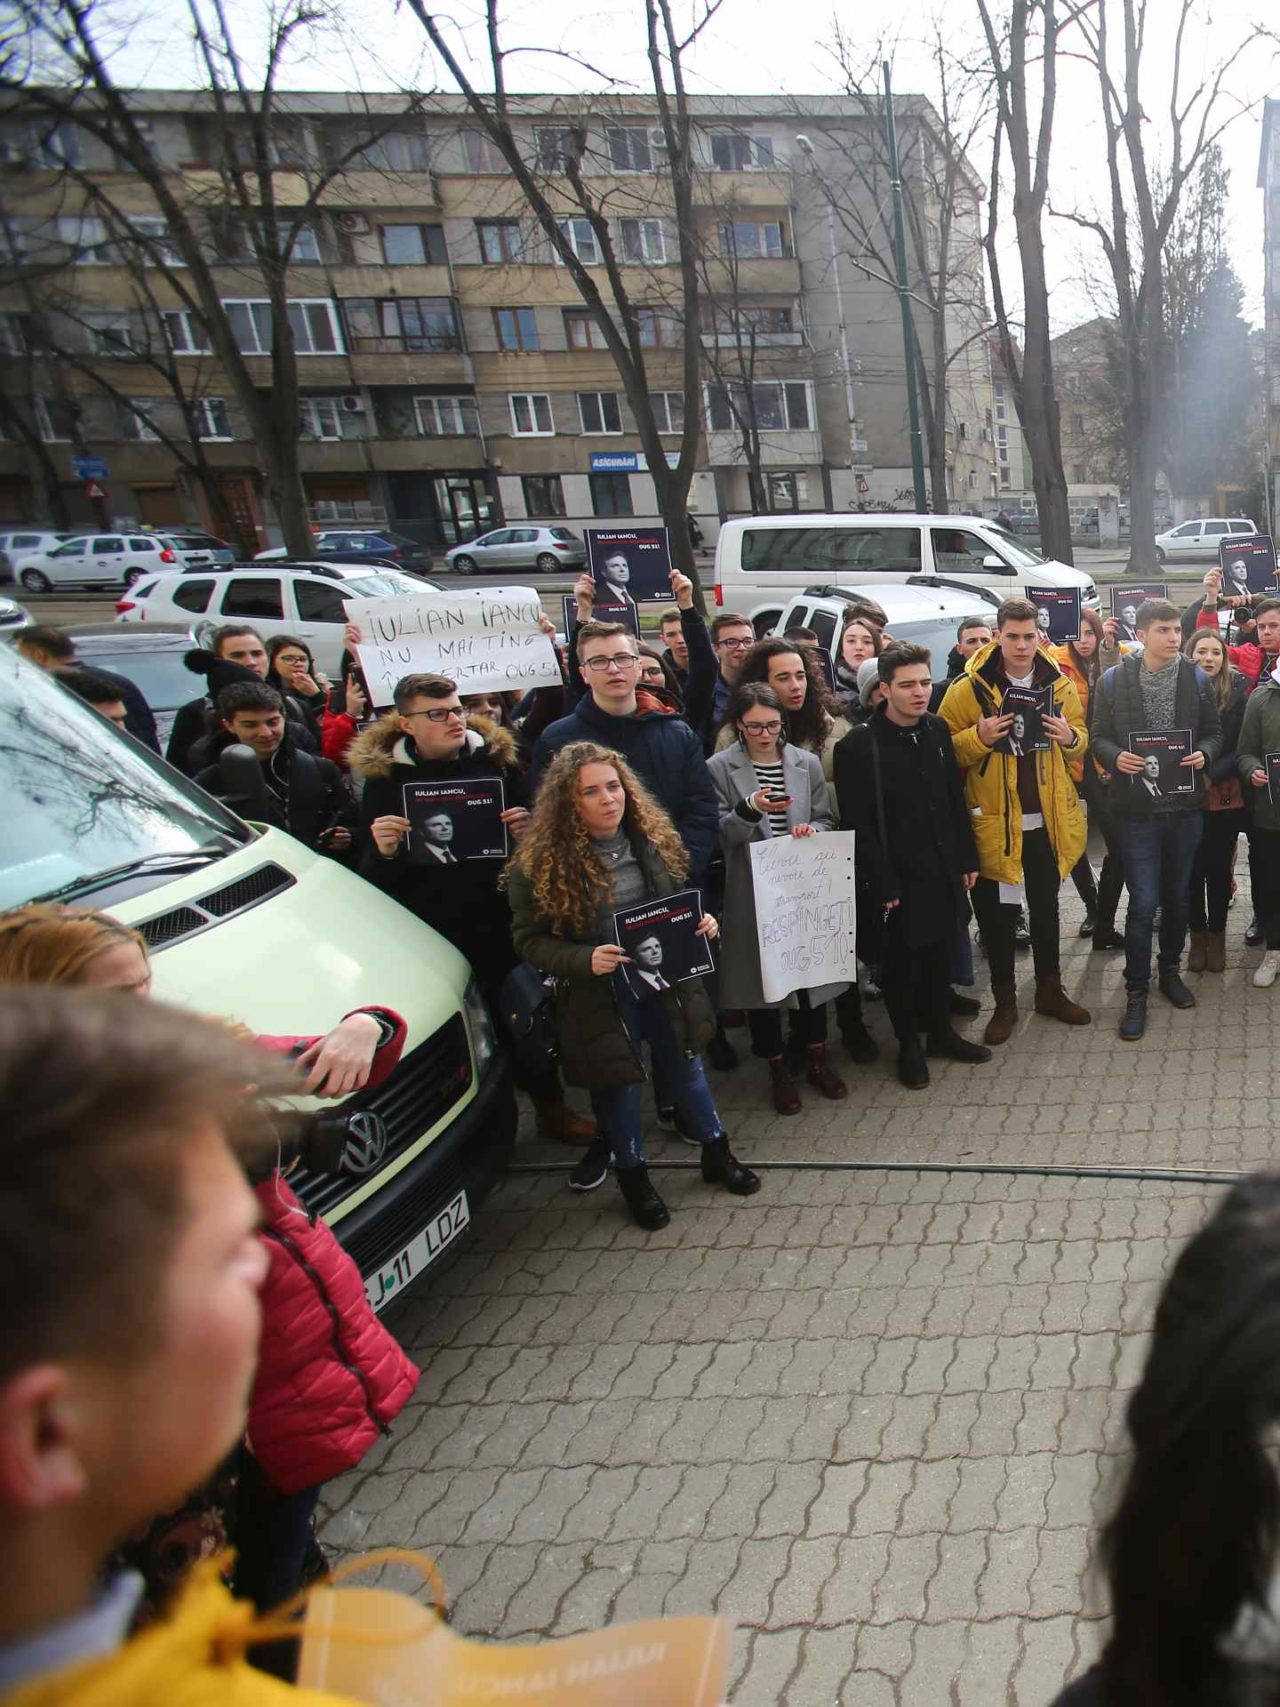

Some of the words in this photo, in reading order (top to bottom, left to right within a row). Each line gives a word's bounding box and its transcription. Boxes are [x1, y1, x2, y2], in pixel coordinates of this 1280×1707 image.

[380, 646, 412, 667] NU
[506, 664, 536, 680] OUG
[625, 914, 647, 924] IULIAN
[648, 906, 669, 918] IANCU,
[671, 915, 684, 923] OUG
[425, 1196, 466, 1256] LDZ
